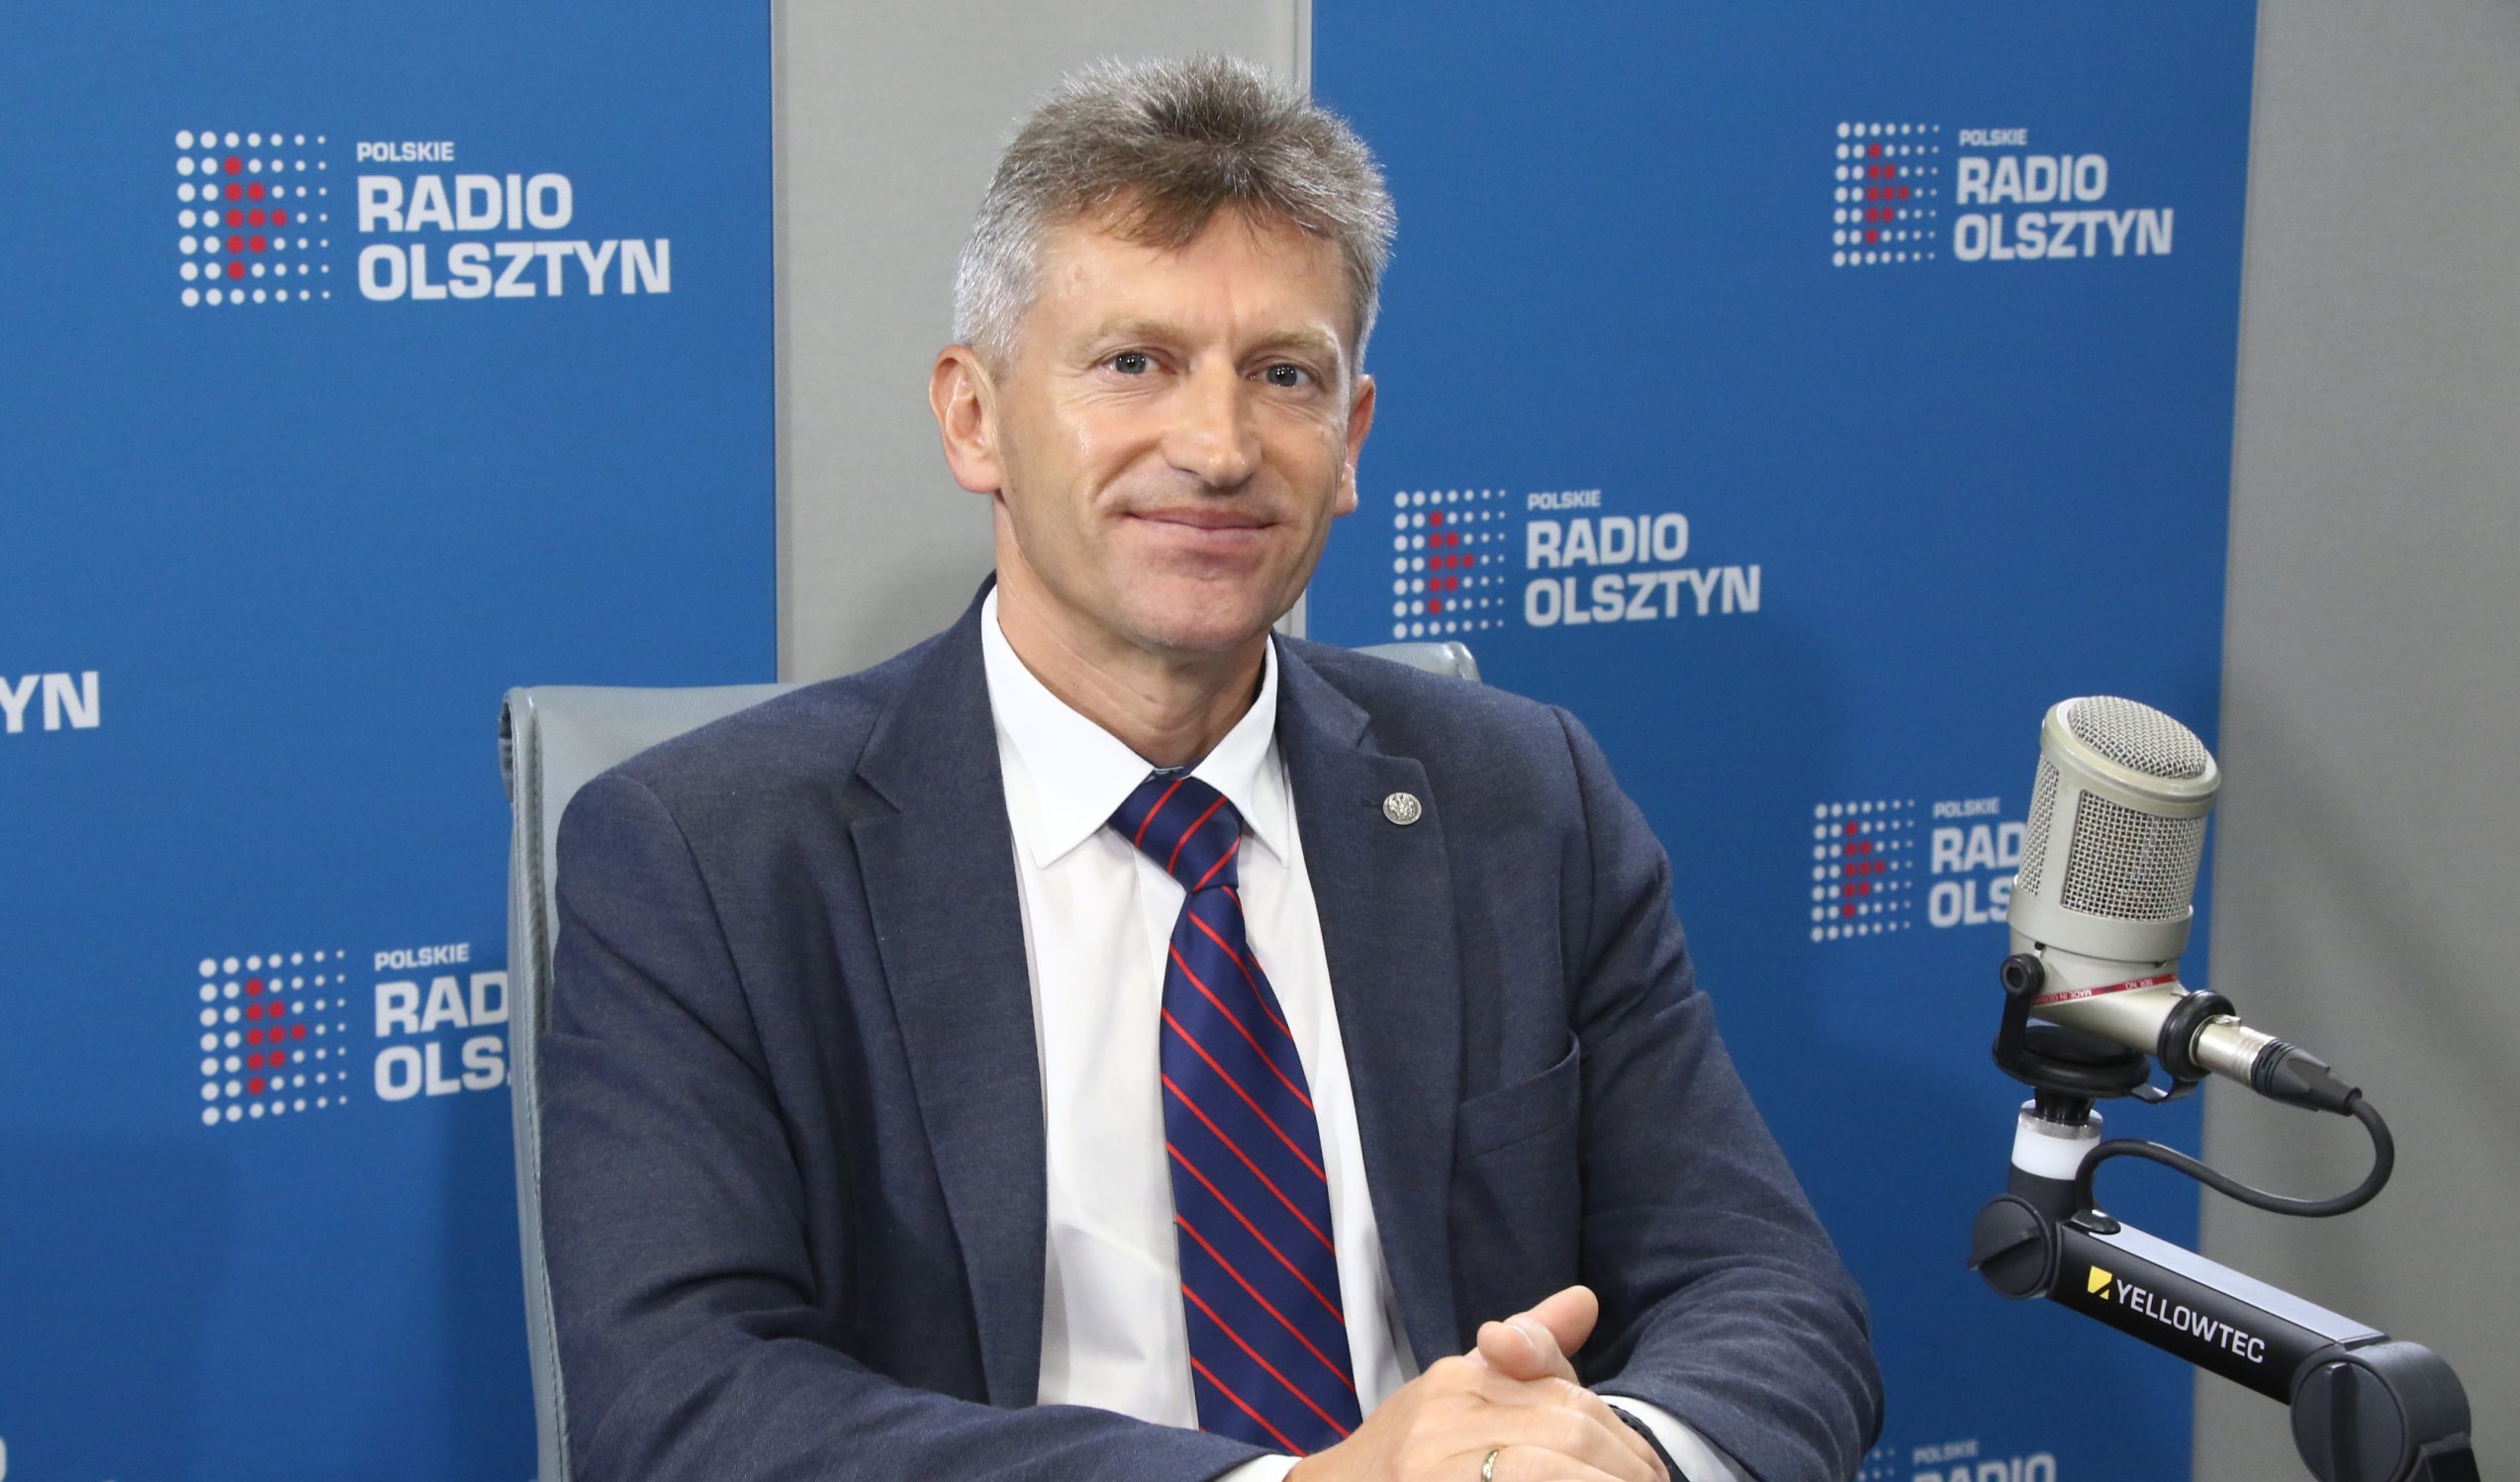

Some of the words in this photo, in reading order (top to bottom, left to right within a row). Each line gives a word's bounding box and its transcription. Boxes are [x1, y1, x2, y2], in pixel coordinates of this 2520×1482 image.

[356, 140, 455, 162] POLSKIE
[1958, 128, 2027, 147] POLSKIE
[357, 172, 573, 232] RADIO
[1956, 153, 2108, 205] RADIO
[1953, 208, 2174, 261] OLSZTYN
[357, 237, 671, 302] OLSZTYN
[1527, 489, 1602, 510] POLSKIE
[1526, 512, 1689, 570] RADIO
[1525, 564, 1761, 627] OLSZTYN
[1932, 797, 2001, 819] POLSKIE
[1931, 822, 2026, 875] RAD
[374, 942, 470, 972] POLSKIE
[375, 971, 509, 1038] RAD
[2070, 989, 2093, 999] MADE
[374, 1036, 512, 1102] OLS
[2116, 1279, 2266, 1364] YELLOWTEC
[1913, 1439, 1979, 1464] POLSKIE
